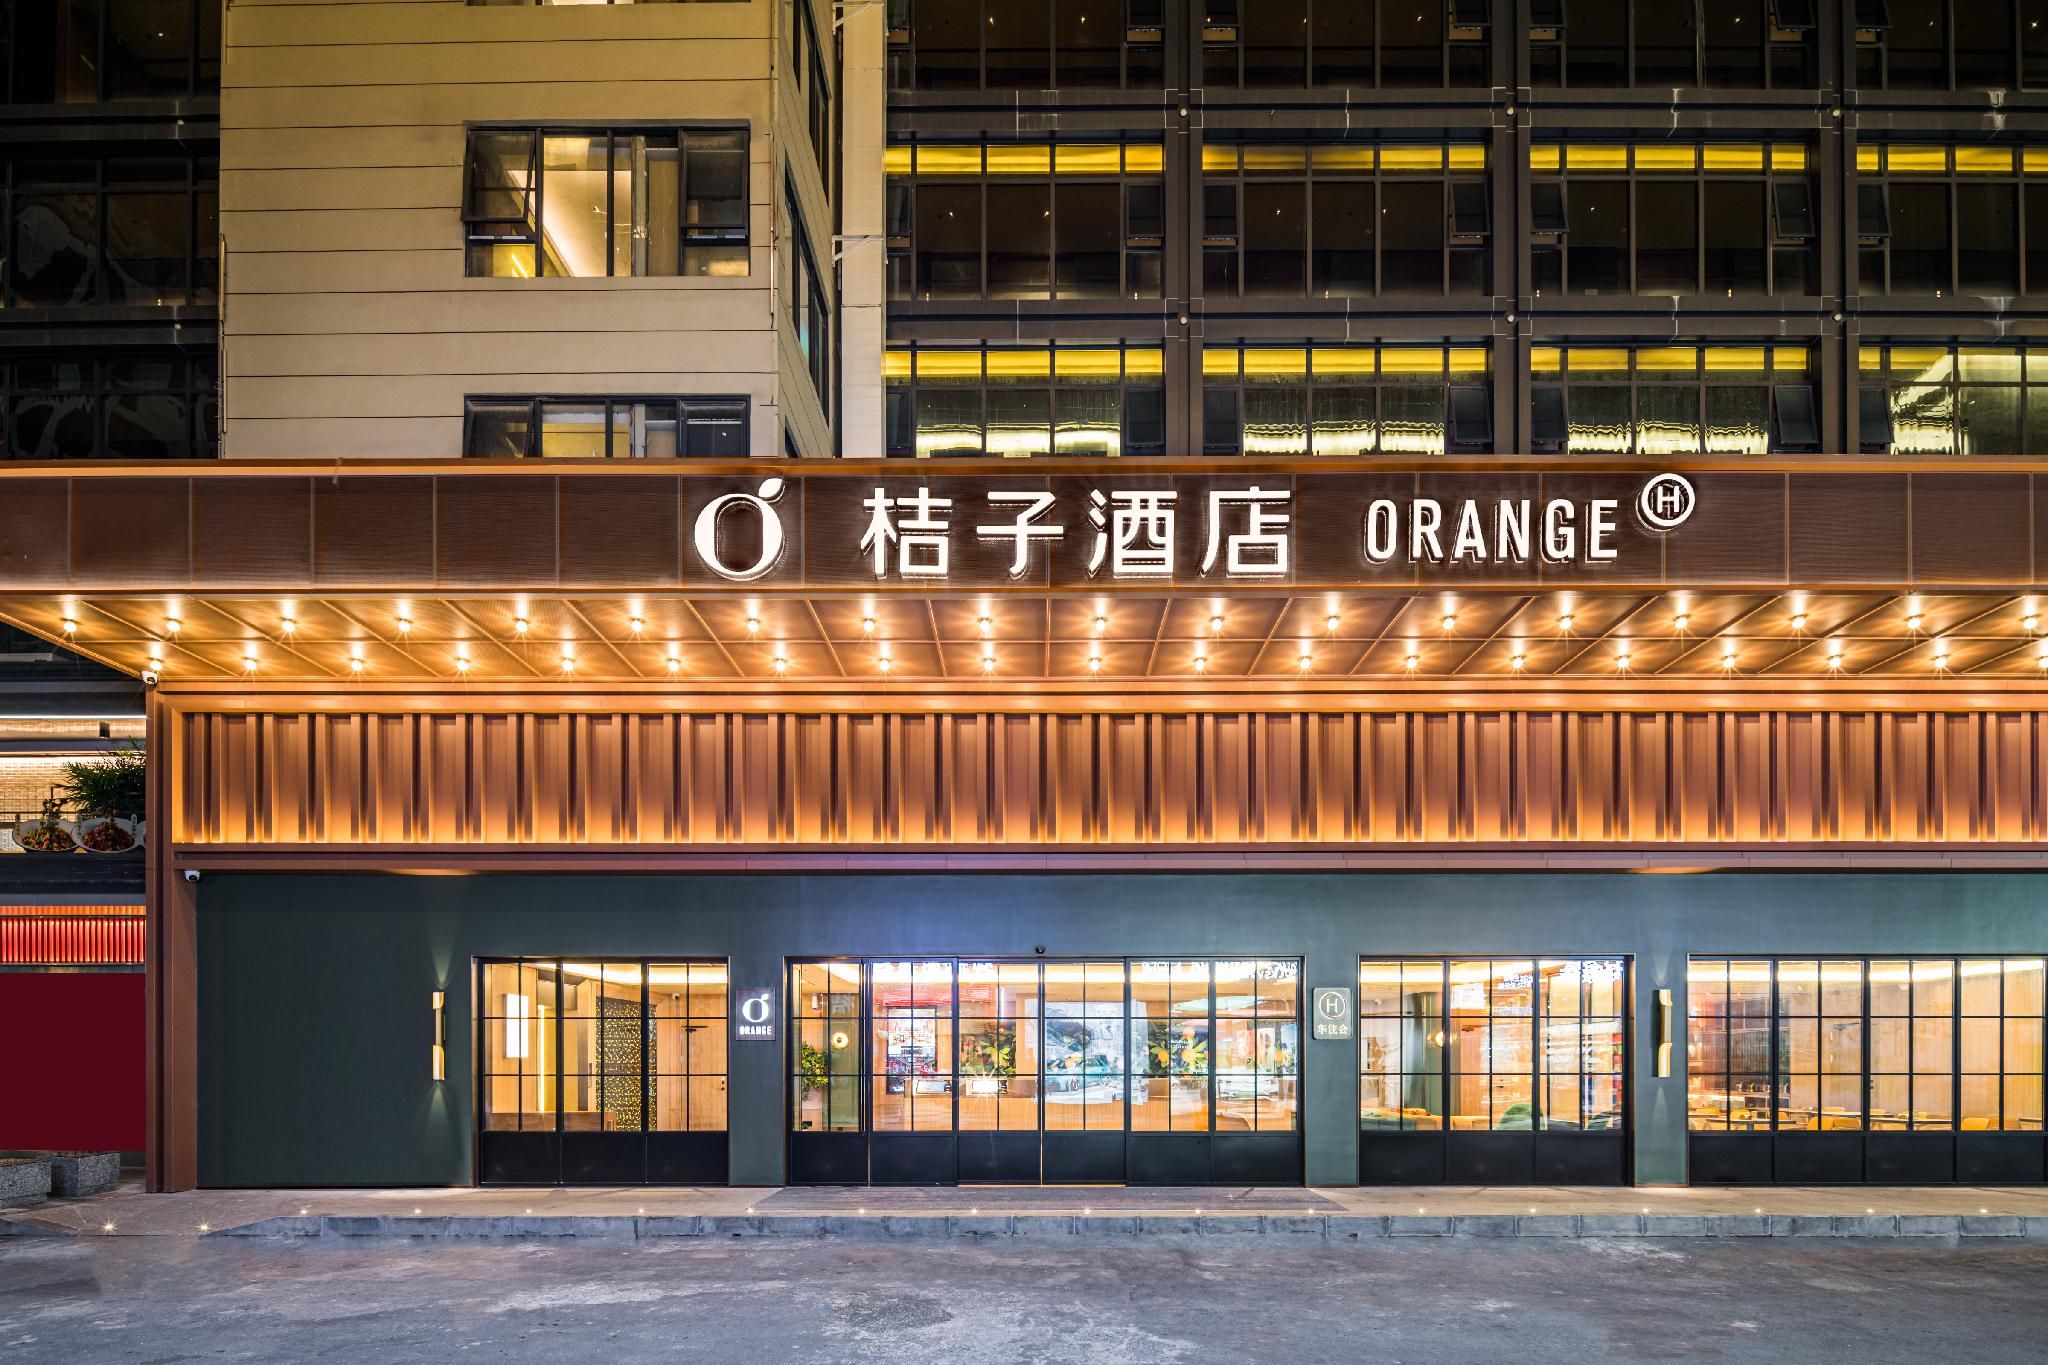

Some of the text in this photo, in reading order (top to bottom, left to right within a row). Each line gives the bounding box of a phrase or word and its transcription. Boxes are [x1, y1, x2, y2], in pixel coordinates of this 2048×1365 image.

[860, 486, 1291, 577] 桔子酒店
[1365, 499, 1619, 561] ORANGE
[739, 1025, 772, 1035] ORANGE
